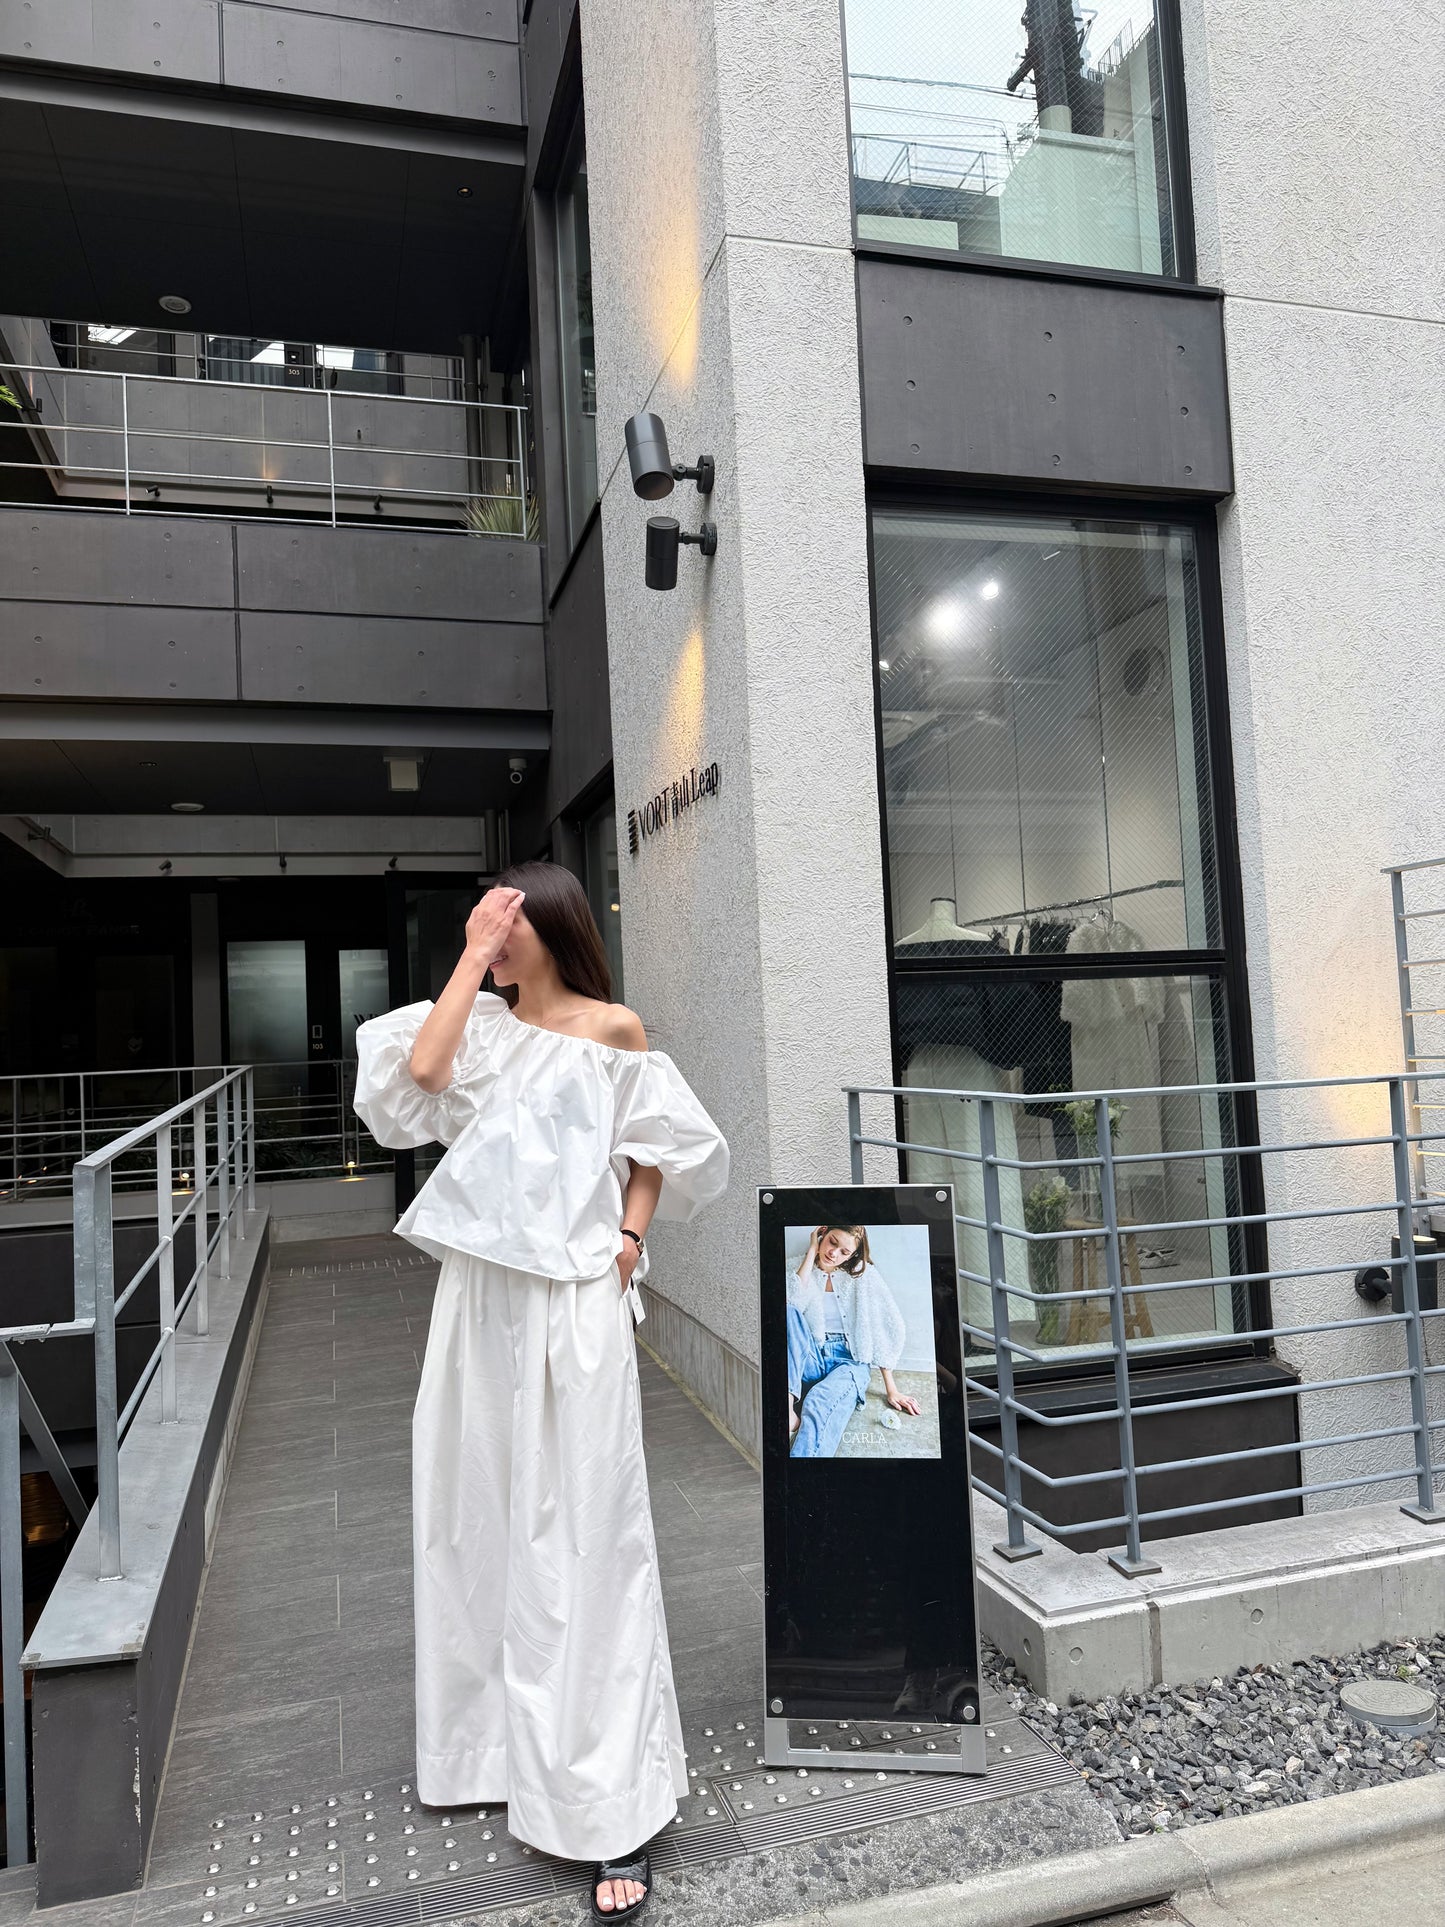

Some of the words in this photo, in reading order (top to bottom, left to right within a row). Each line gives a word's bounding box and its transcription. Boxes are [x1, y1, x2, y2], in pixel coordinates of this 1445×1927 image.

[638, 787, 669, 840] VORT
[671, 775, 690, 819] 青山
[690, 762, 719, 803] Leap
[842, 1431, 888, 1444] CARLA
